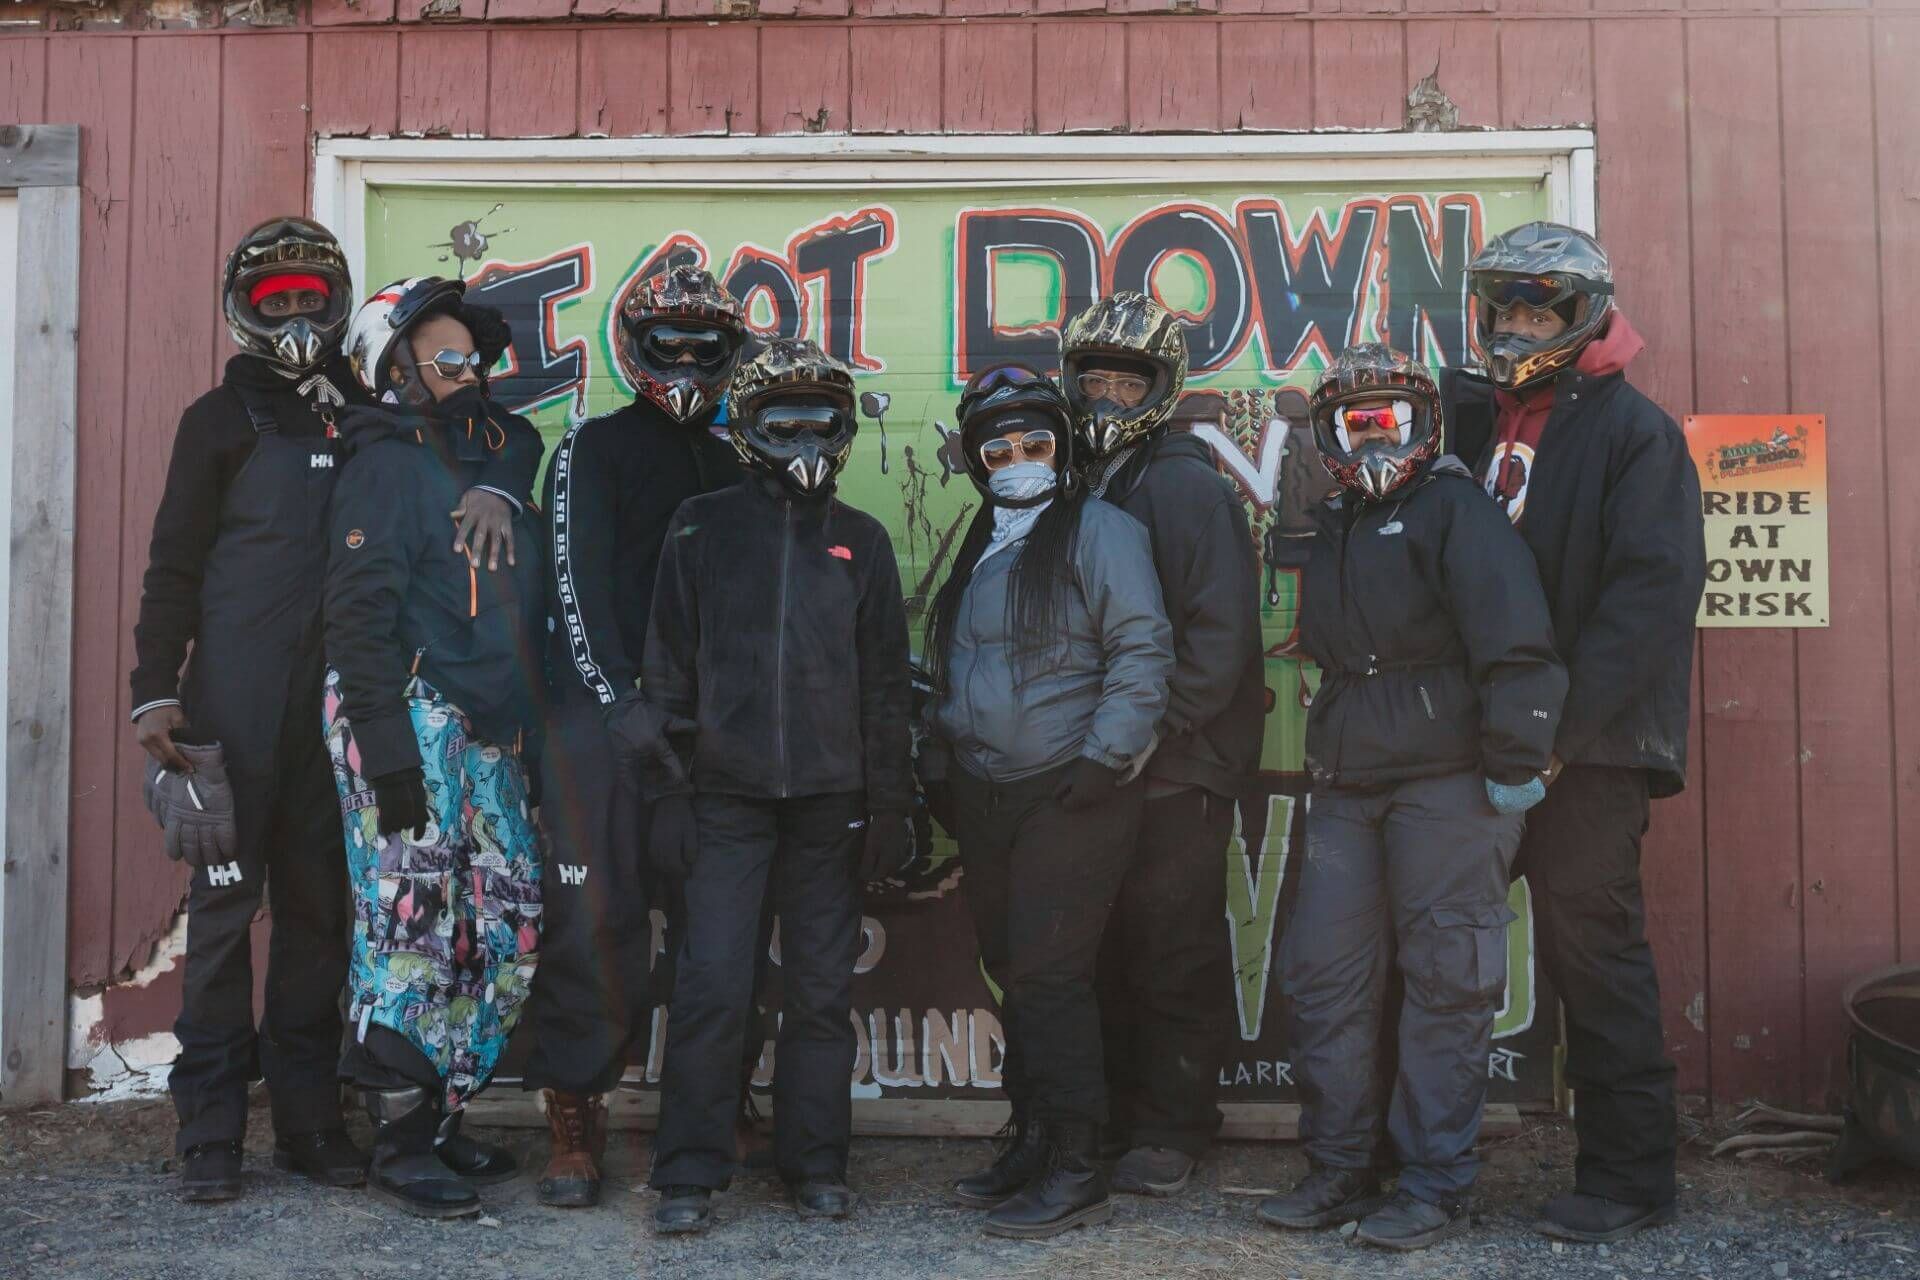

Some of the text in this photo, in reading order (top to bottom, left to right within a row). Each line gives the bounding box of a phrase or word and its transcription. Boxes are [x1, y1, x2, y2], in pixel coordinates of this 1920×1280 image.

[953, 193, 1488, 387] DOWN
[310, 454, 334, 468] HH
[1703, 491, 1811, 515] RIDE
[1729, 525, 1785, 548] AT
[1706, 559, 1811, 582] OWN
[1704, 592, 1813, 616] RISK
[207, 860, 242, 886] HH
[558, 863, 588, 887] HH
